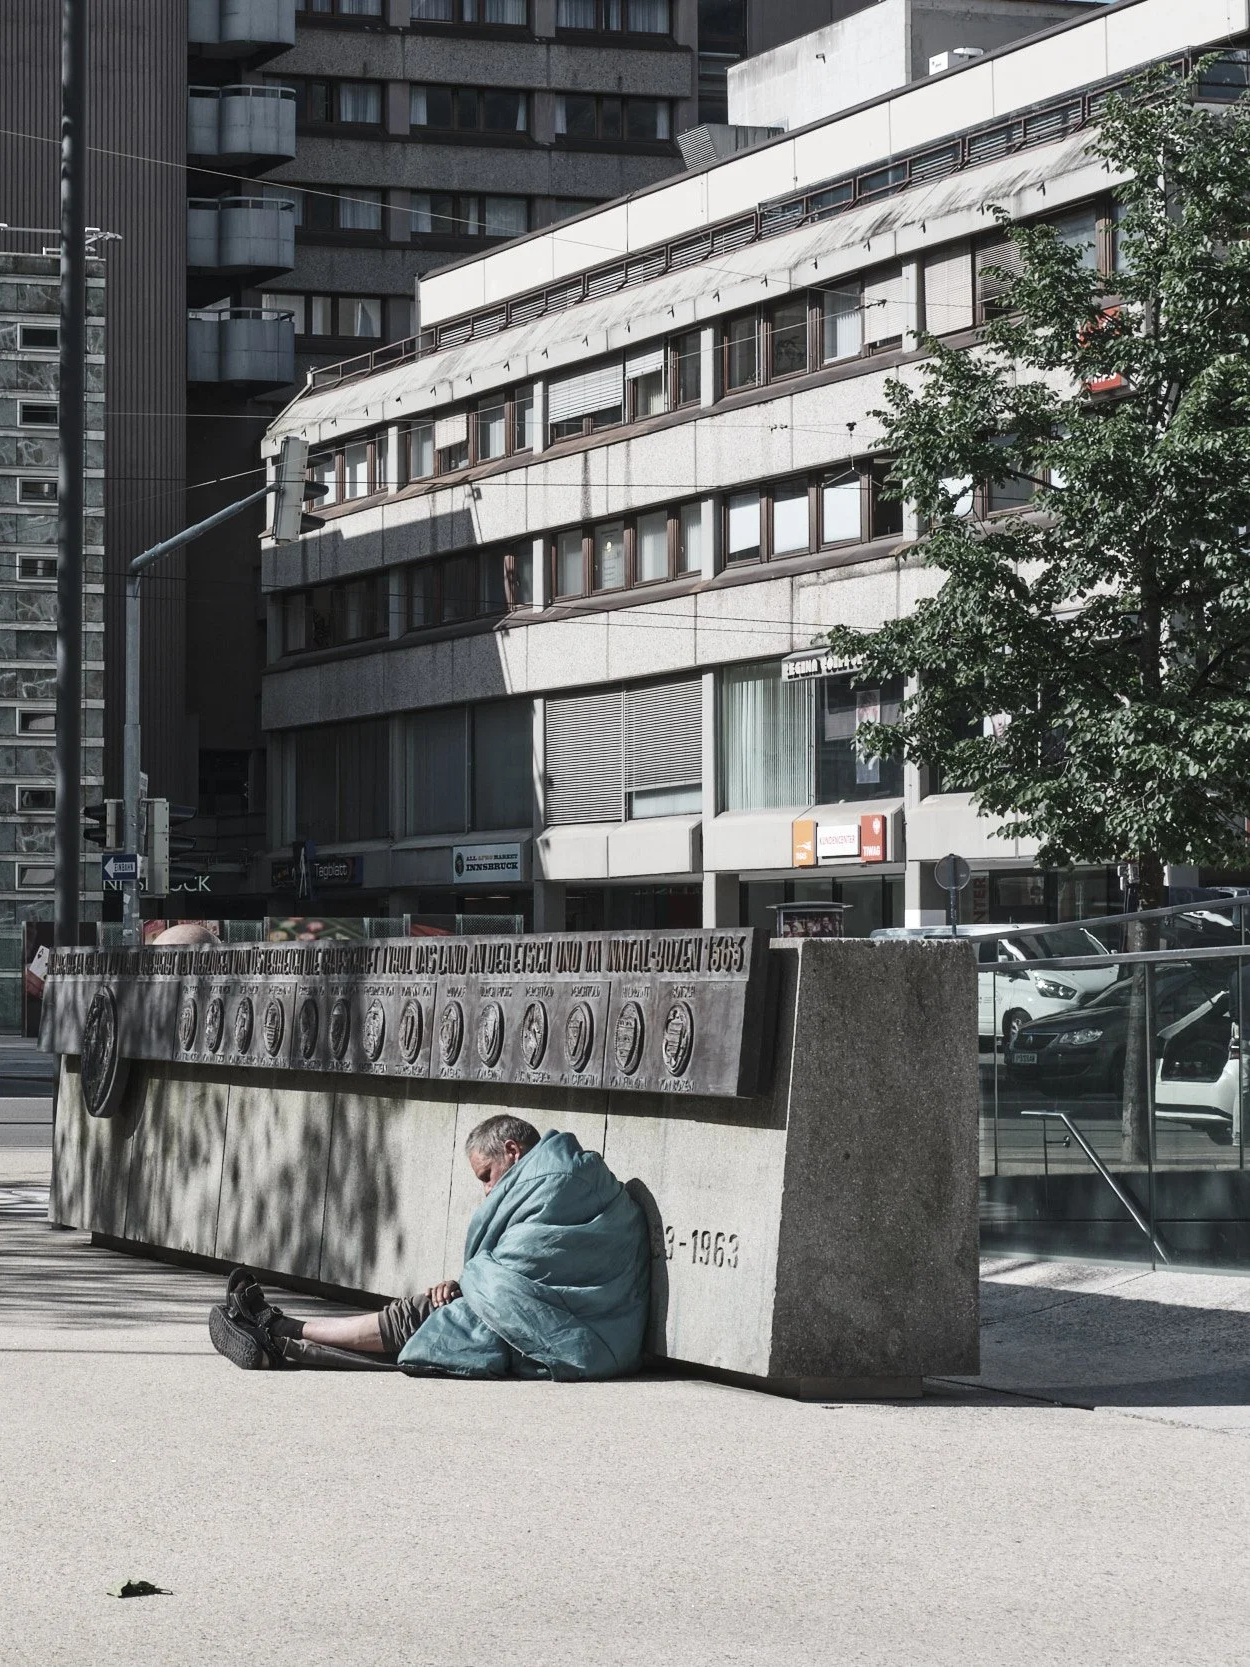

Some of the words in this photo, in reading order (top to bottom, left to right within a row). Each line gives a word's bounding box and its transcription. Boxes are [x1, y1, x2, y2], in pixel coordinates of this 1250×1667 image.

[863, 845, 881, 857] TIWAG
[114, 863, 134, 872] EINBAHN
[466, 862, 519, 872] INNSBRUCK
[250, 946, 304, 975] ÖSTERREICH
[414, 944, 437, 974] DAS
[437, 944, 468, 975] LAND
[469, 943, 487, 975] AN
[487, 942, 512, 974] DER
[512, 941, 553, 974] ETSCH
[555, 940, 583, 973] UND
